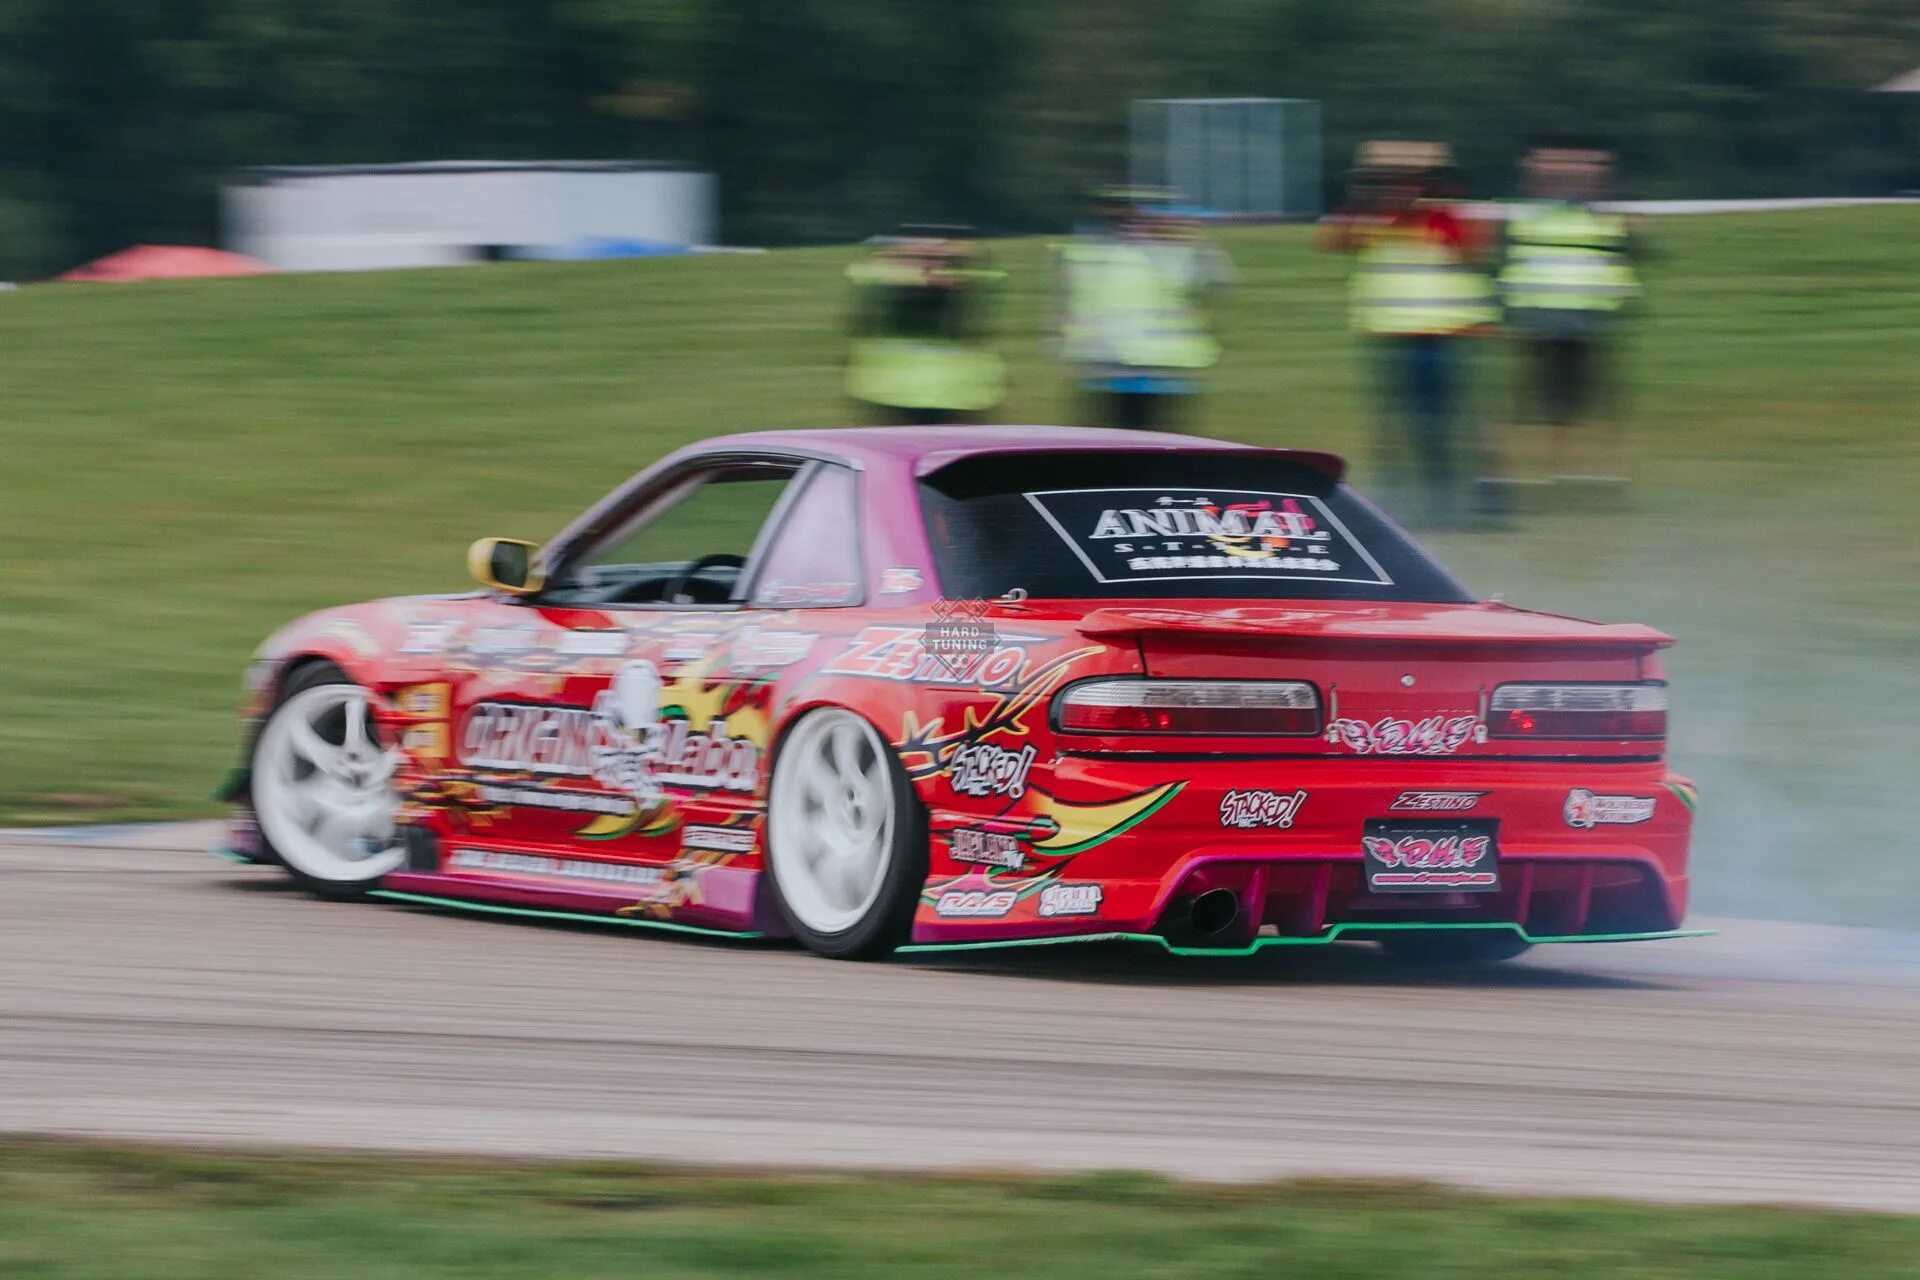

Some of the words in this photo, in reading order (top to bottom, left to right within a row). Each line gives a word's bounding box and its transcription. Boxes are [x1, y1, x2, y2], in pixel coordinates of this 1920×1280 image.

[1089, 508, 1331, 541] ANIMAL
[1220, 790, 1308, 829] STACKED!
[1390, 792, 1481, 810] ZESTINO
